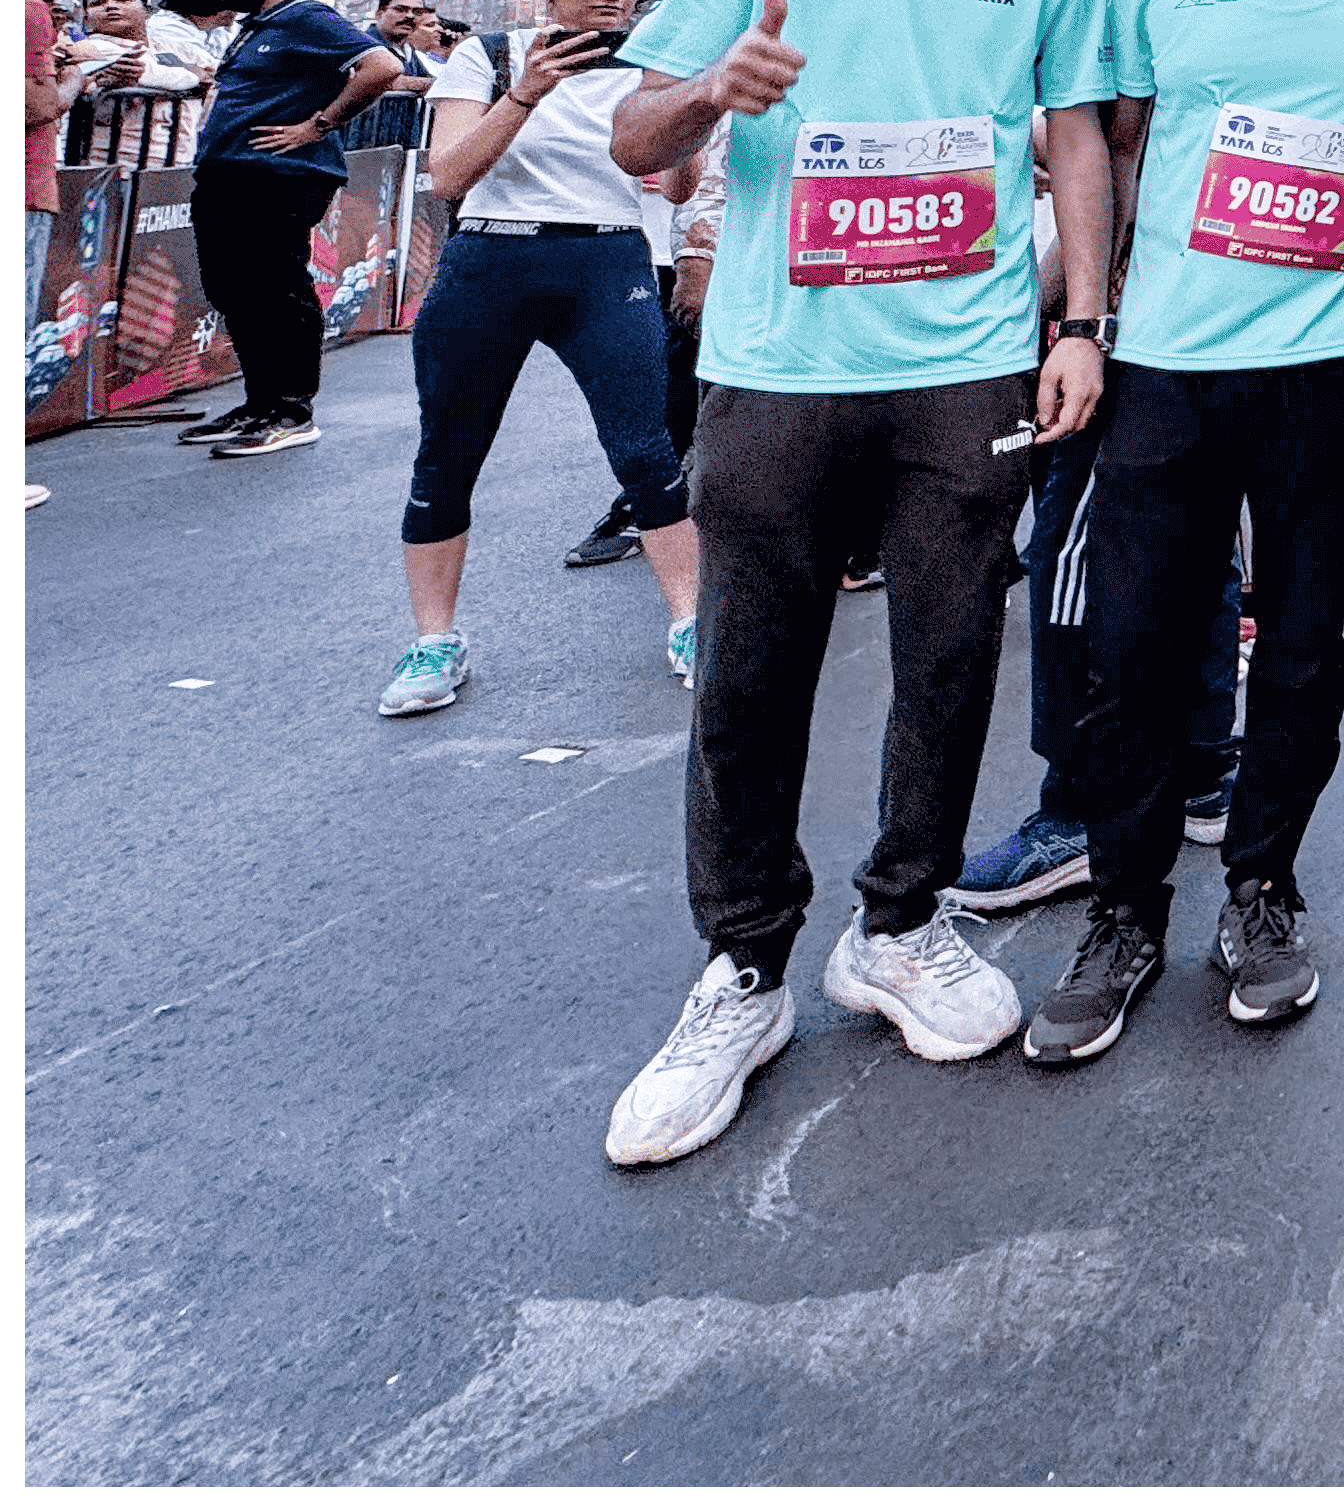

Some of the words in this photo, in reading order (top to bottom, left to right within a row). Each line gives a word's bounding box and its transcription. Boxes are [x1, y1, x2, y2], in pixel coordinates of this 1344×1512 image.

[1219, 135, 1255, 152] TATA
[1261, 141, 1283, 156] tcs
[802, 158, 850, 170] TATA
[858, 156, 885, 169] tcs
[1227, 176, 1341, 225] 90582
[828, 191, 965, 236] 90583
[1266, 250, 1292, 262] FIRST
[894, 266, 923, 277] FIRST
[924, 263, 949, 274] Bank
[992, 429, 1033, 456] PUMA
